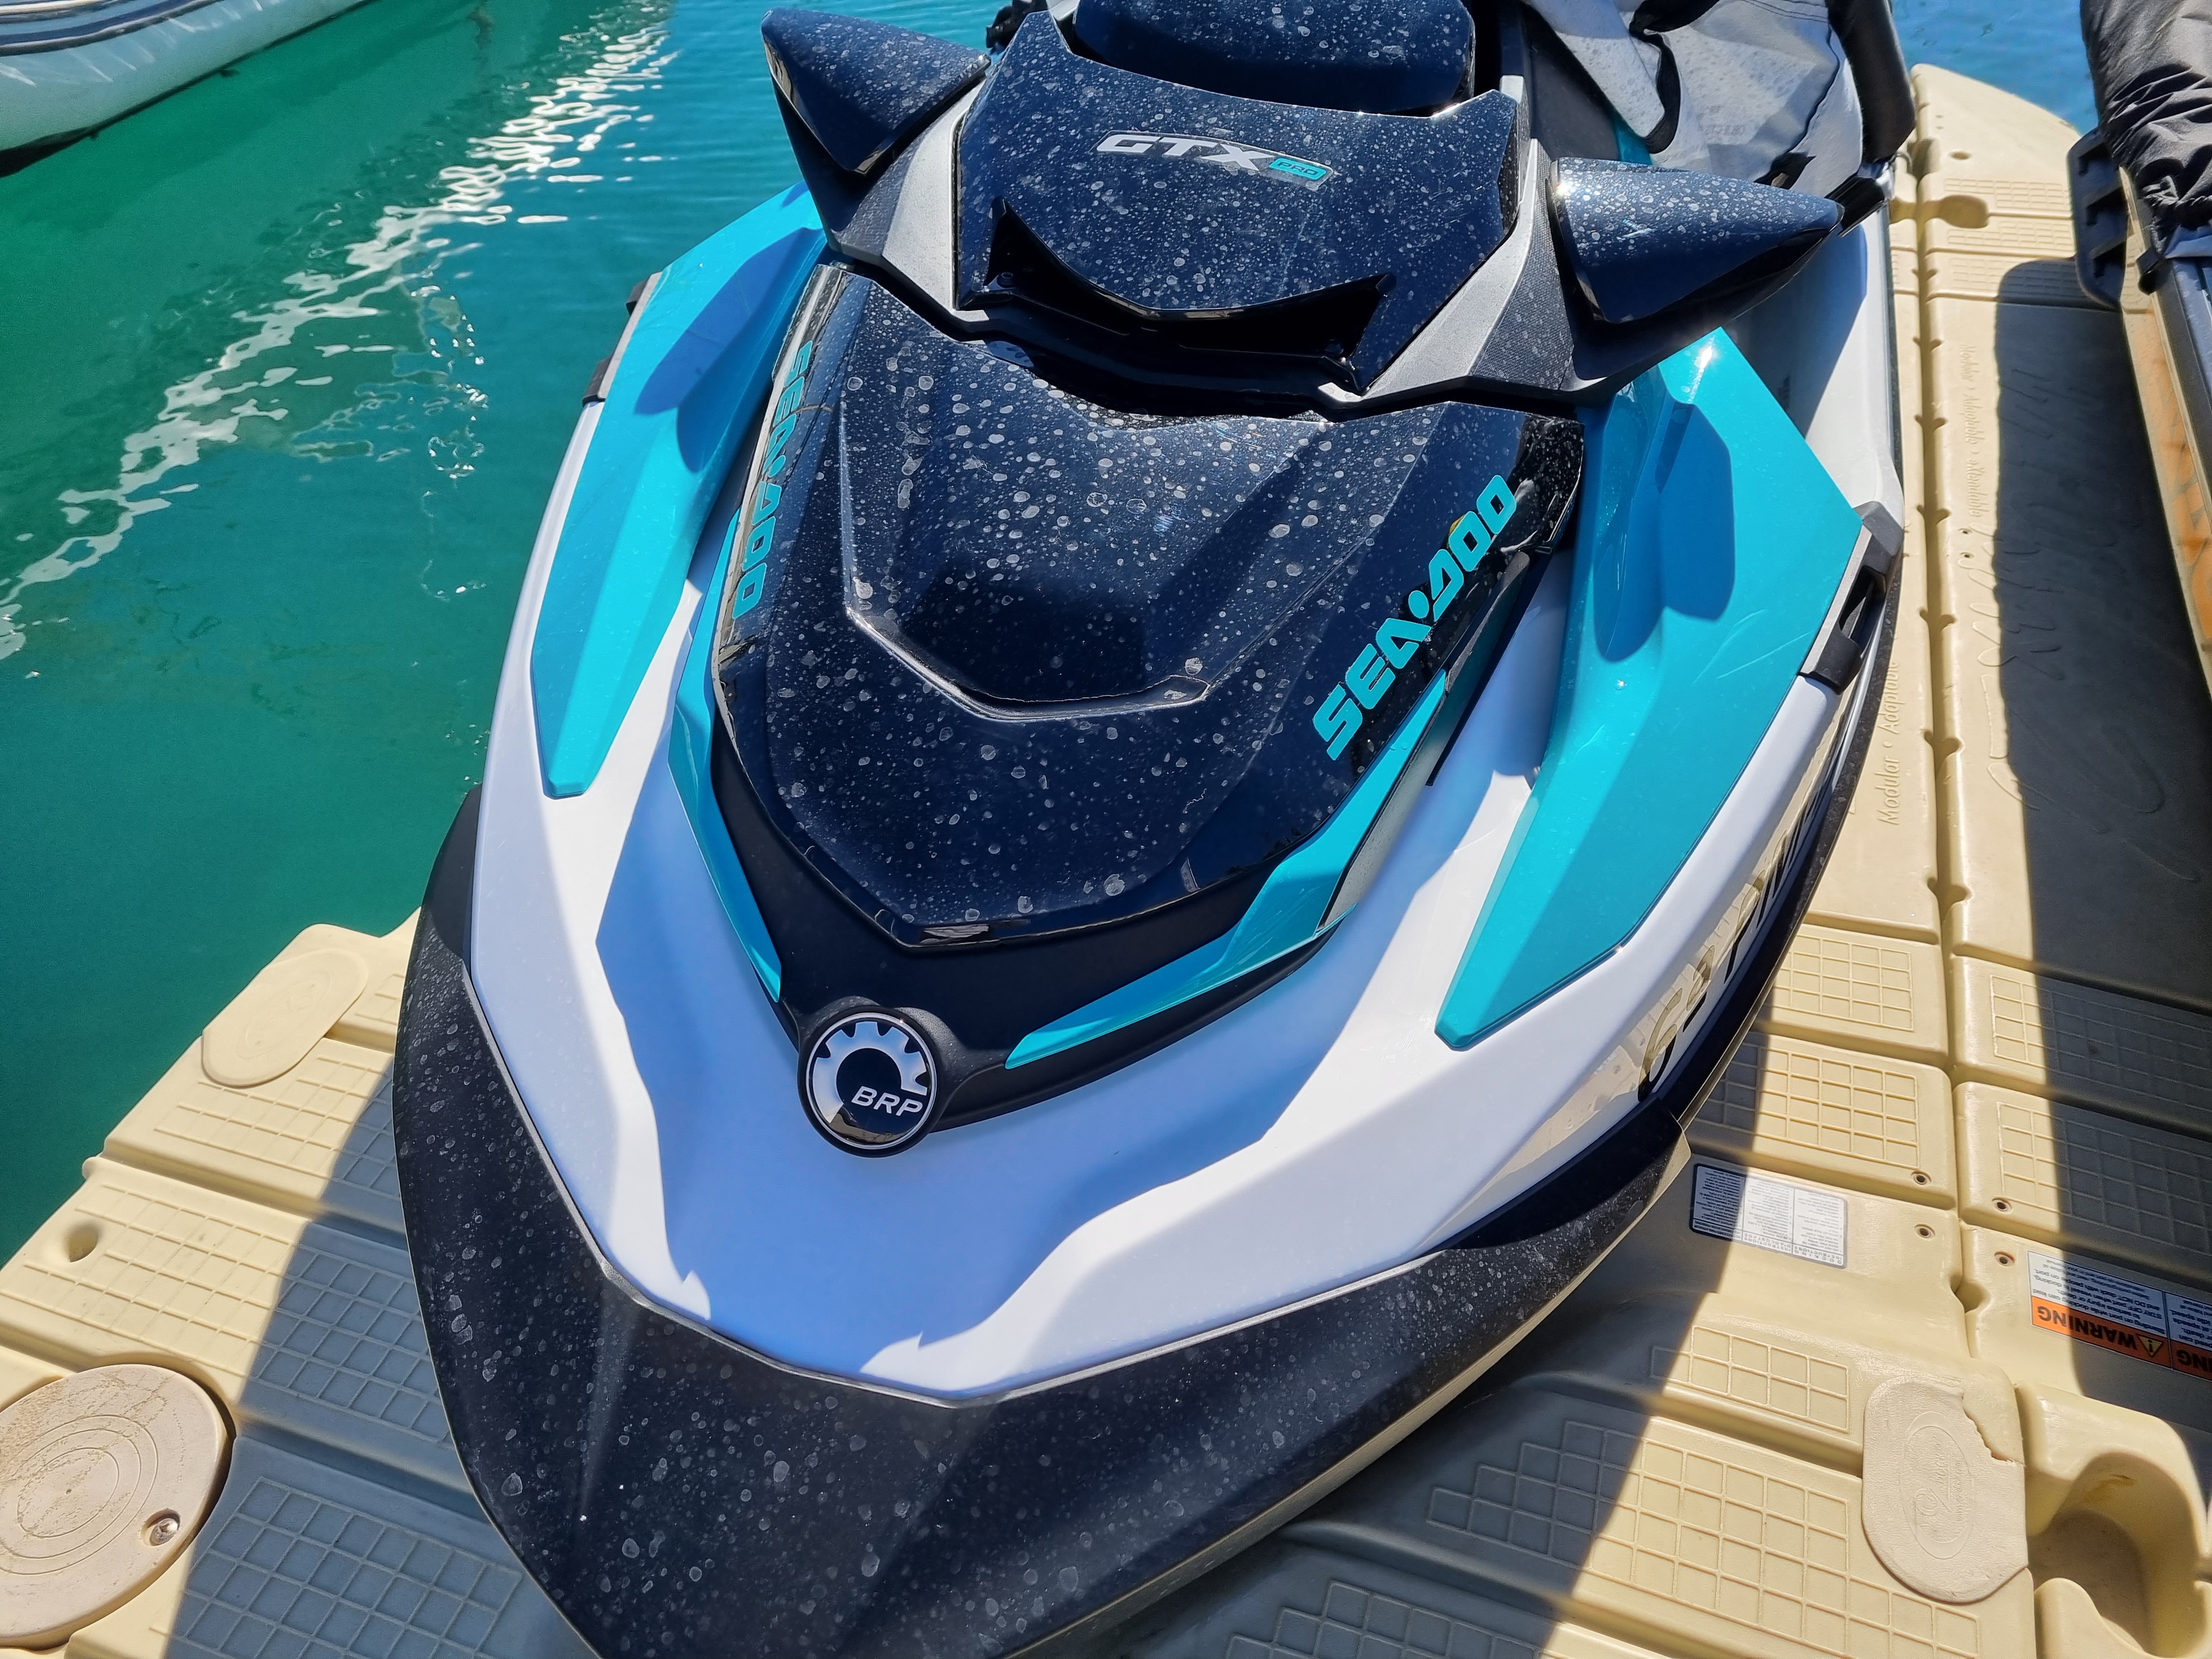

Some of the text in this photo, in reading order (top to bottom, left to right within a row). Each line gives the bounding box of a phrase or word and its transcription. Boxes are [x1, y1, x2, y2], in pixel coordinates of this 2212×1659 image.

[1097, 134, 1321, 177] GTX PRO
[1875, 755, 1900, 825] Modular
[851, 1085, 923, 1116] BRP
[2037, 1304, 2137, 1351] WARNING
